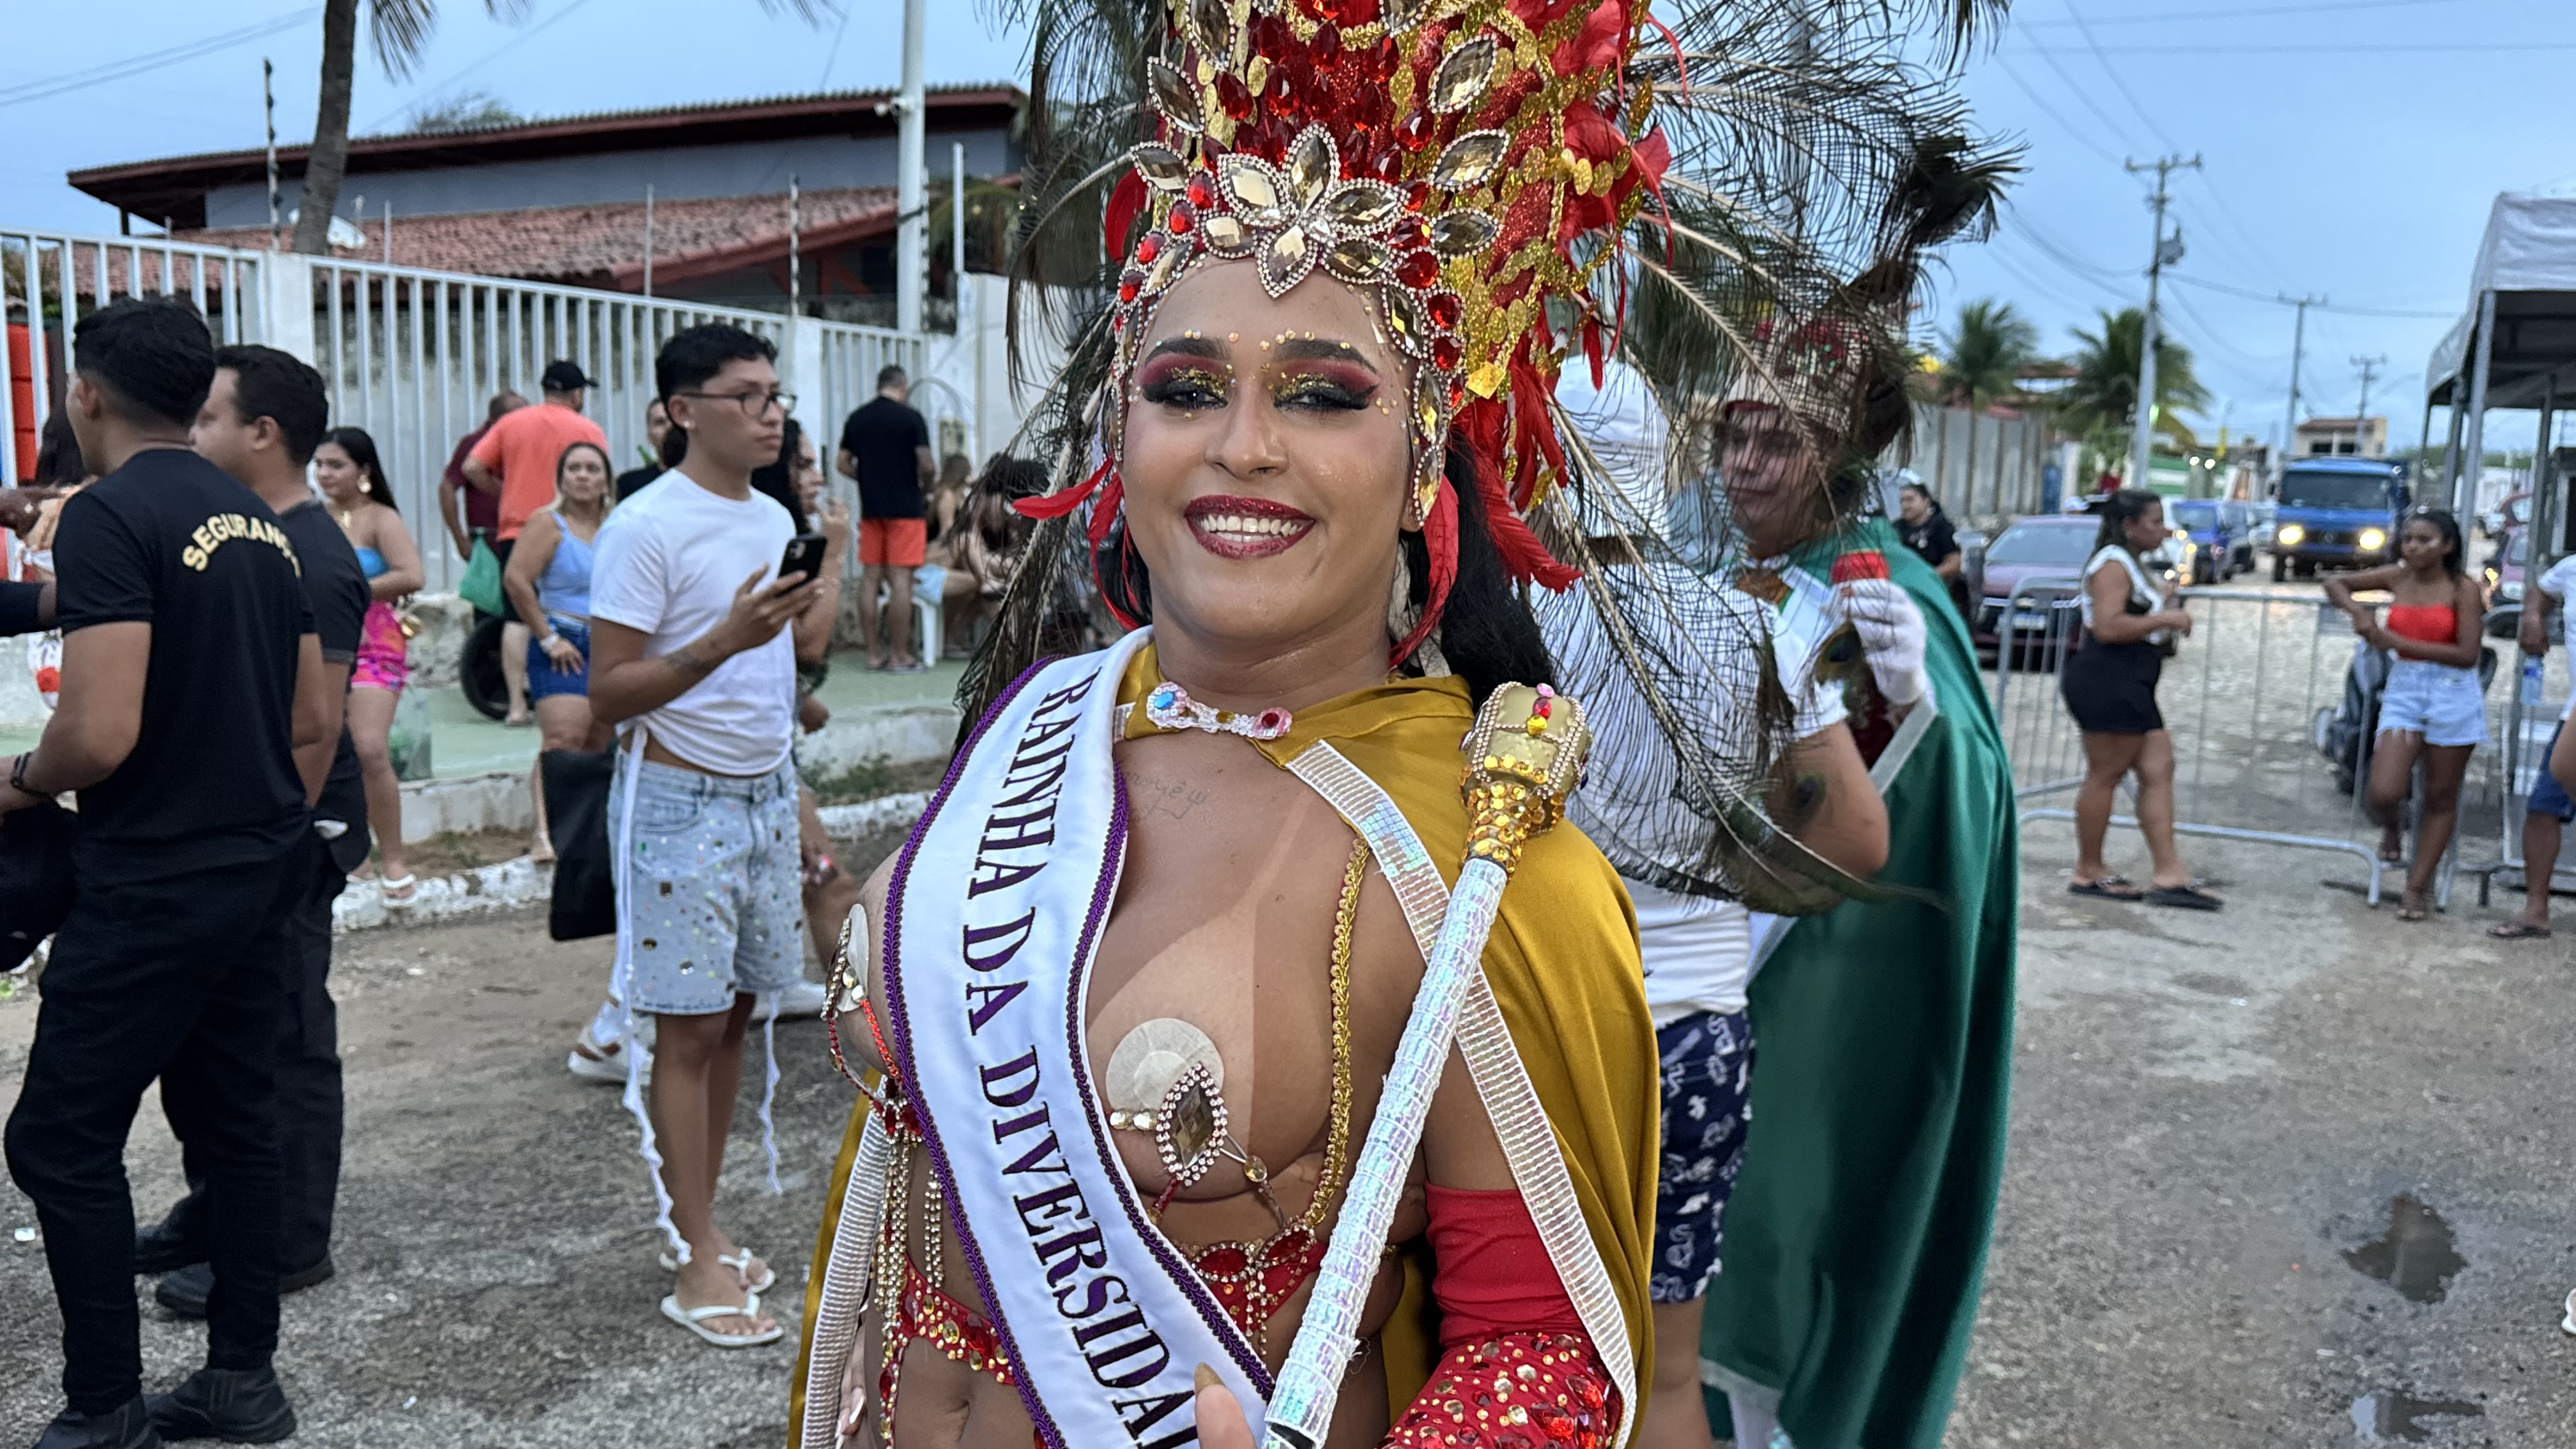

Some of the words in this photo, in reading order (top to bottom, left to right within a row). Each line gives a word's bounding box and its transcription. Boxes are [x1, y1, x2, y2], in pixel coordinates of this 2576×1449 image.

[182, 513, 302, 579] SEGURAN
[967, 666, 1103, 900] RAINHA
[963, 906, 1036, 1036] DA
